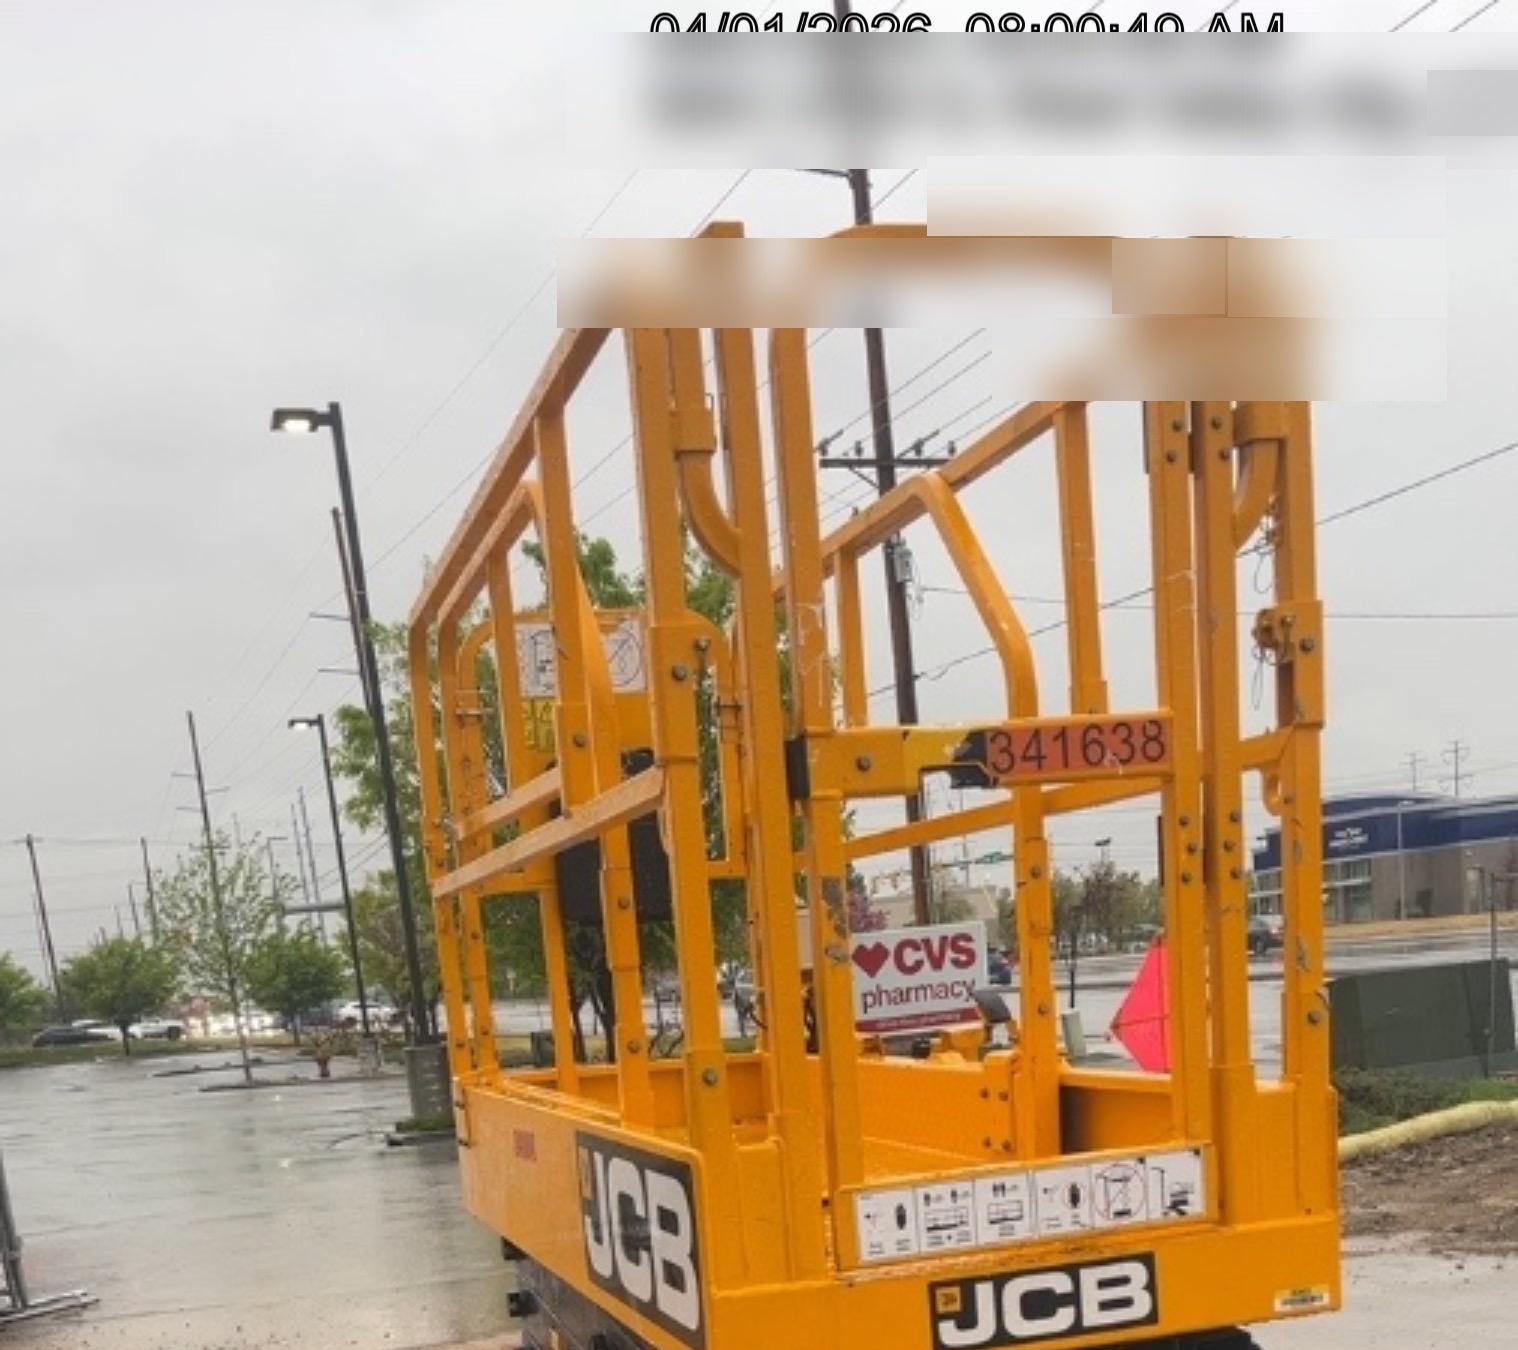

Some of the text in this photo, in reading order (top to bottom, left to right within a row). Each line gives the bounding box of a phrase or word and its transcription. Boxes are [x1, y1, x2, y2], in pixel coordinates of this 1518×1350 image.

[989, 719, 1165, 774] 341638
[893, 932, 976, 976] CVS
[861, 978, 976, 1015] pharmacy
[584, 1150, 700, 1331] JCB
[937, 1260, 1153, 1348] JCB
